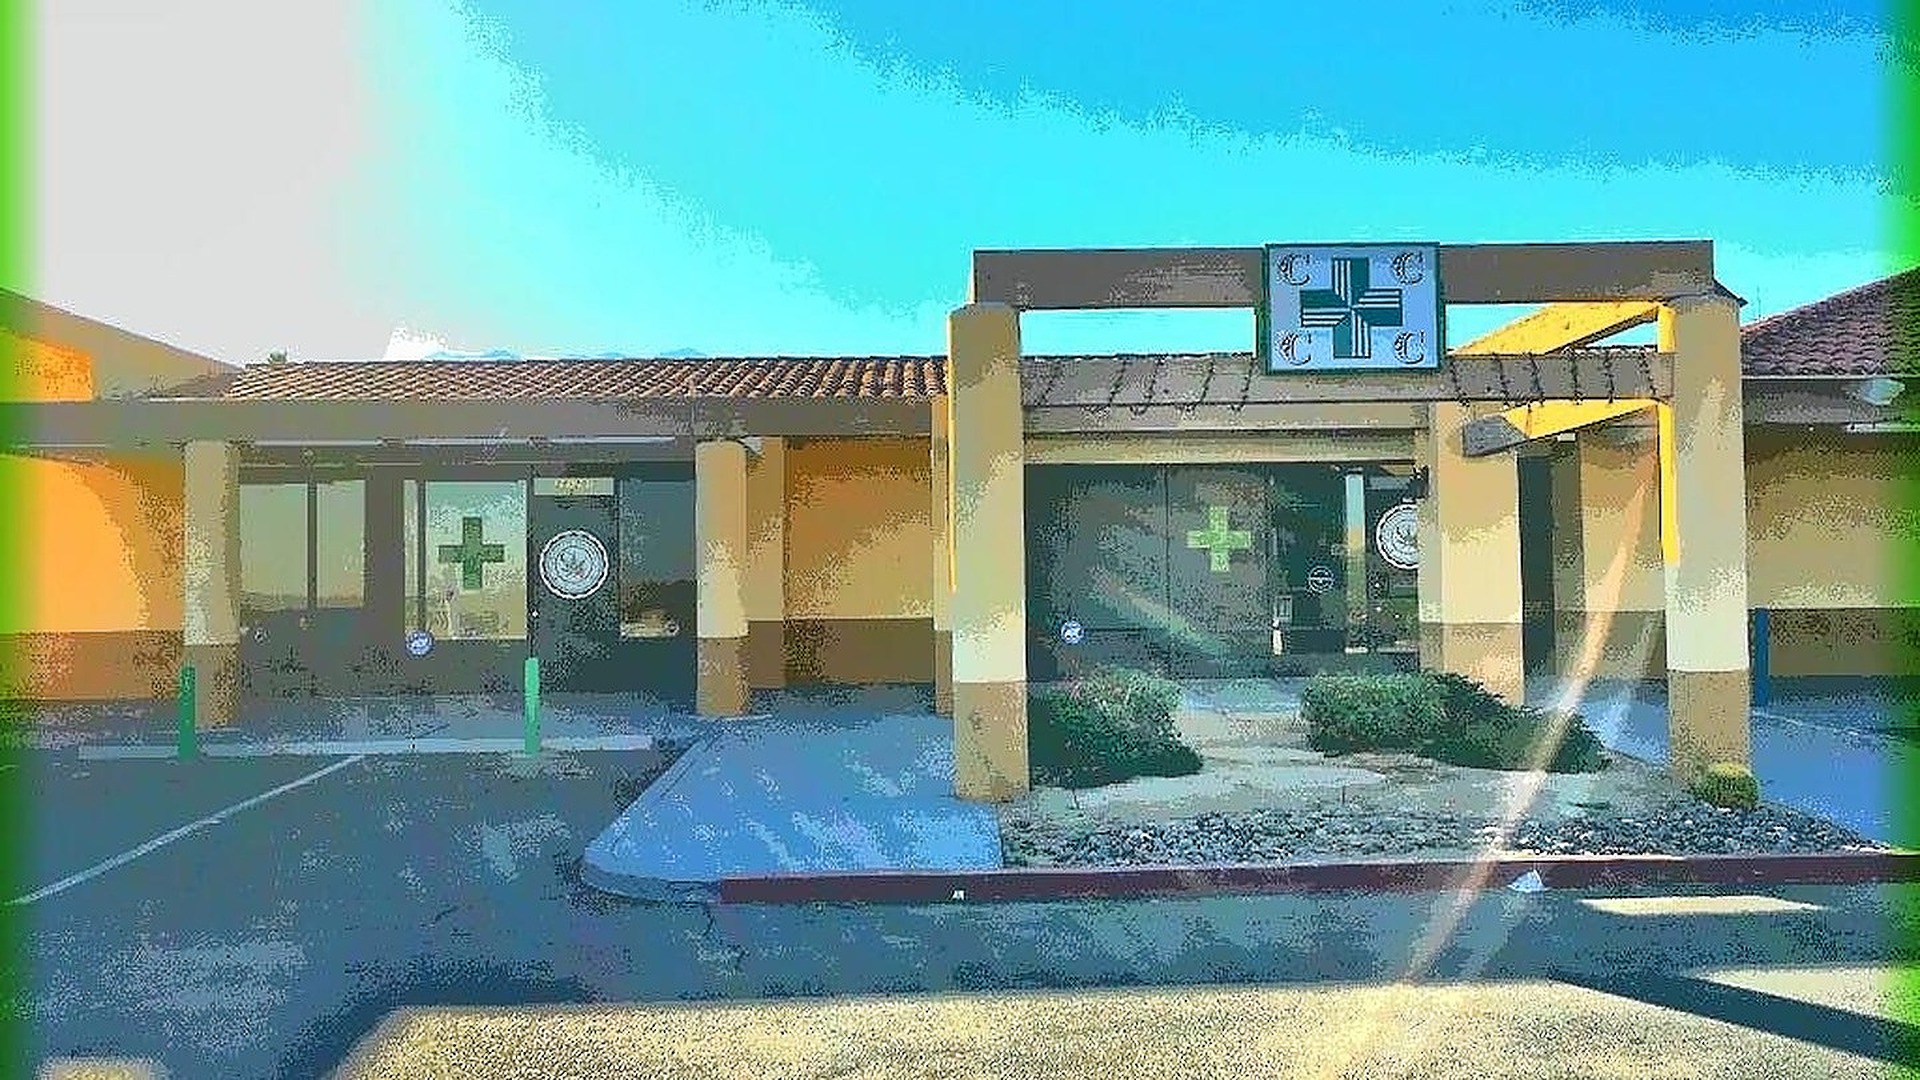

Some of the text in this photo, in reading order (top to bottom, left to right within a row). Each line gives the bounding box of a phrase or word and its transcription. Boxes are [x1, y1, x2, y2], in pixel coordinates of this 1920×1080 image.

[1279, 251, 1423, 286] C C
[1280, 331, 1424, 366] C C
